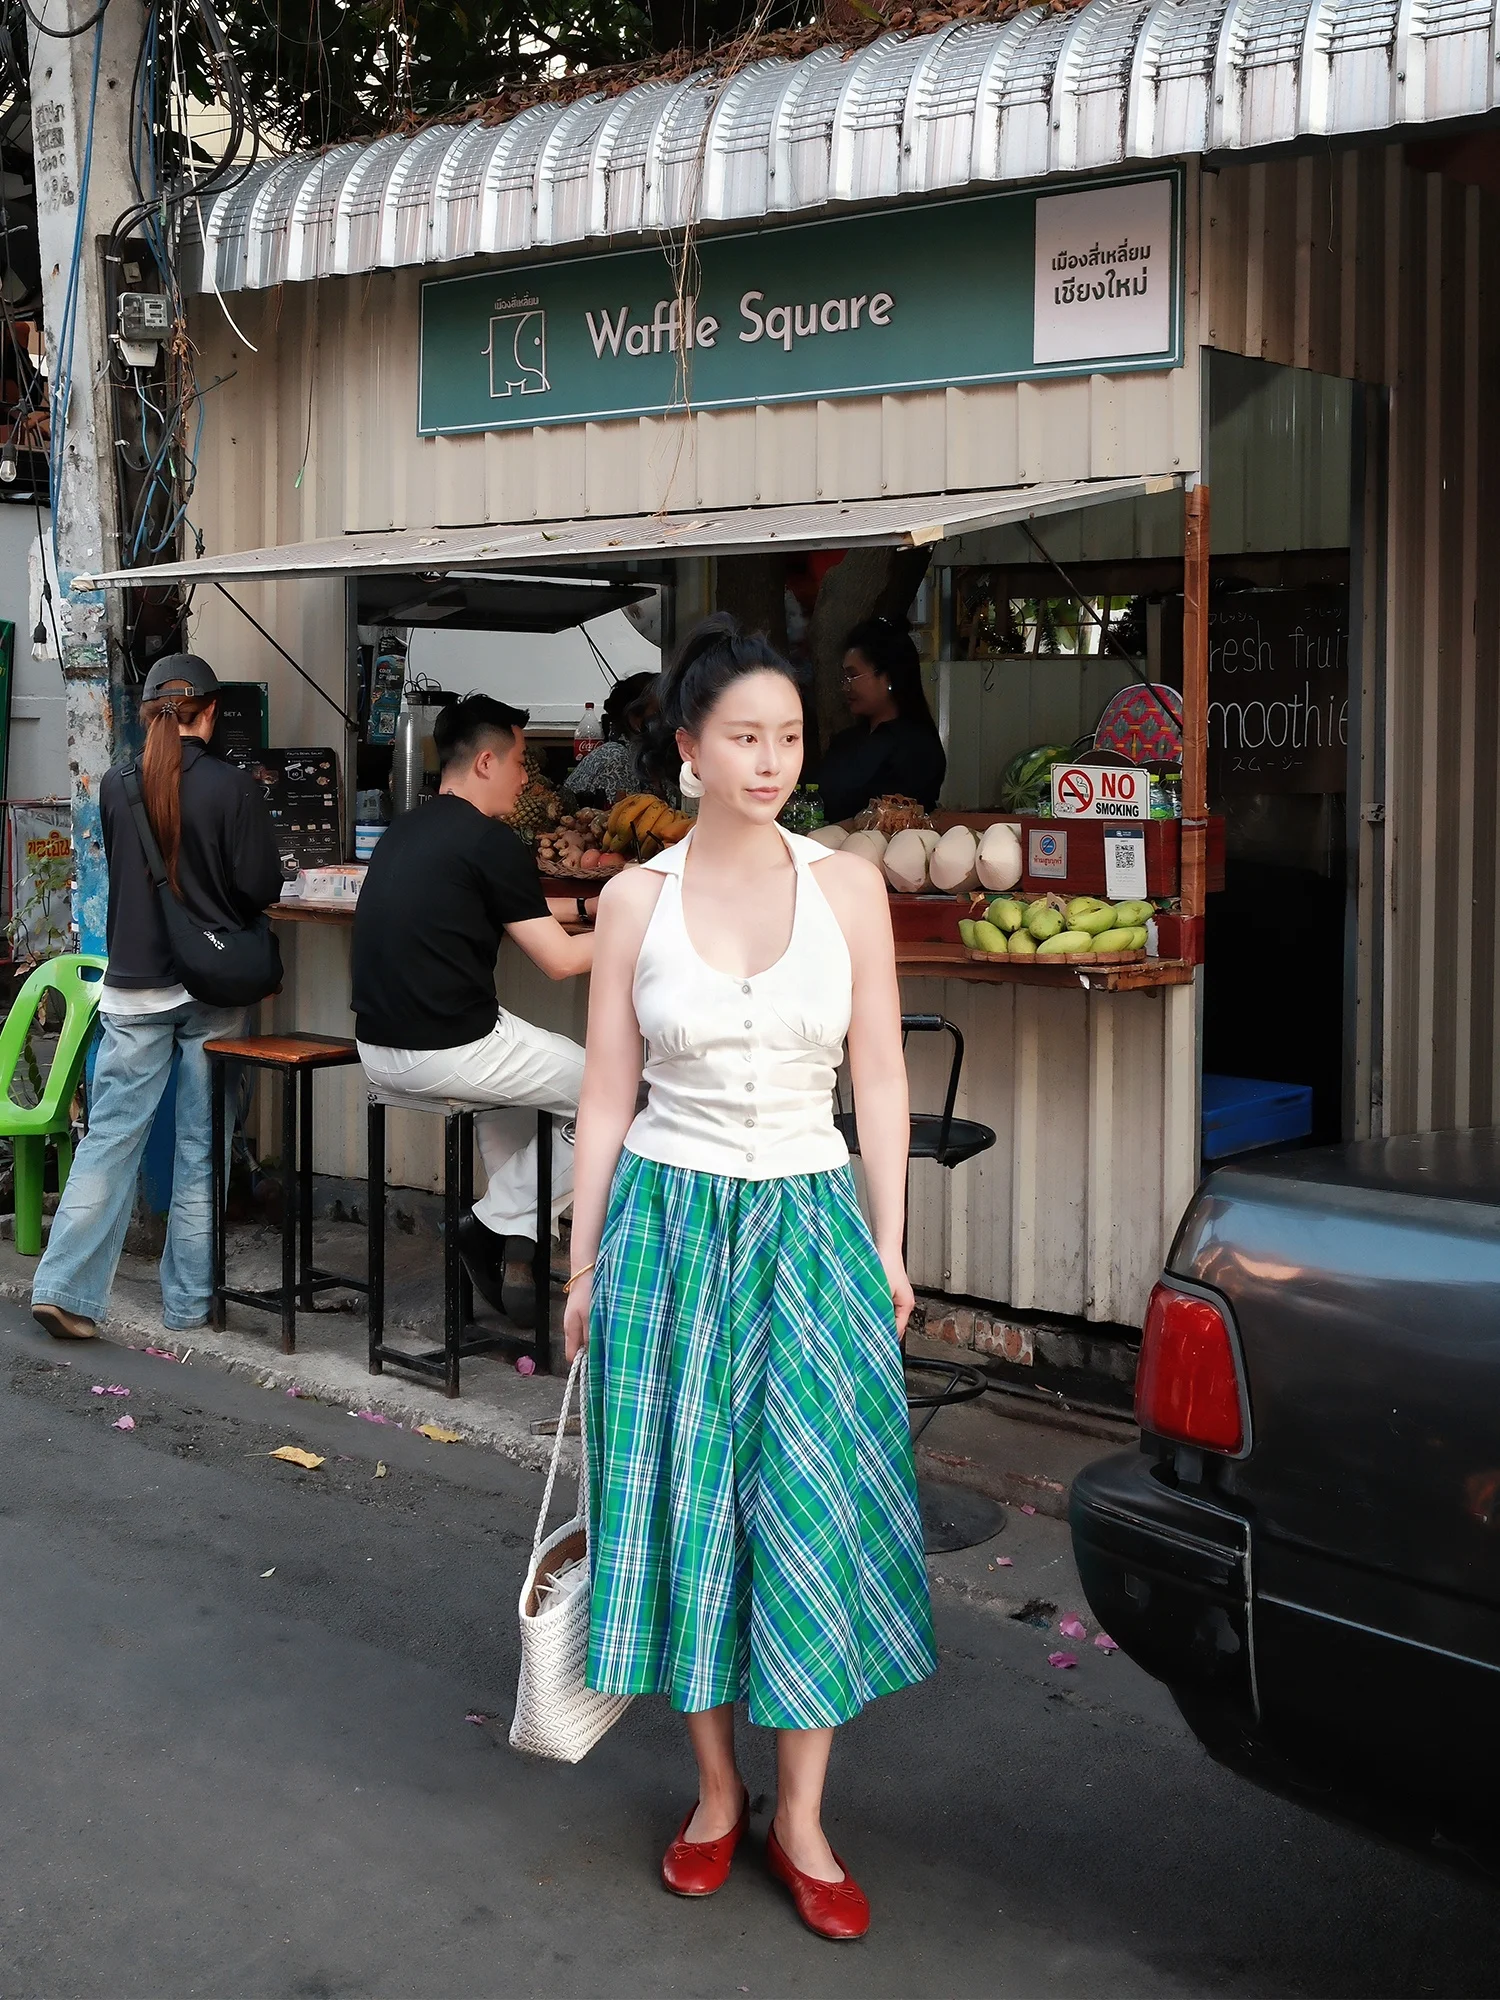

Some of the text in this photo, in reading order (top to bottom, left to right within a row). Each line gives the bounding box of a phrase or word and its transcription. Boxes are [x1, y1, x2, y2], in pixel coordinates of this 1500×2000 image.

[1051, 238, 1151, 271] เมืองสี่เหลี่ยม
[1054, 266, 1148, 305] เชียงใหม่
[585, 290, 896, 359] Waffle Square
[1209, 620, 1274, 673] resh
[1101, 772, 1135, 800] NO
[1095, 802, 1139, 818] SMOKING
